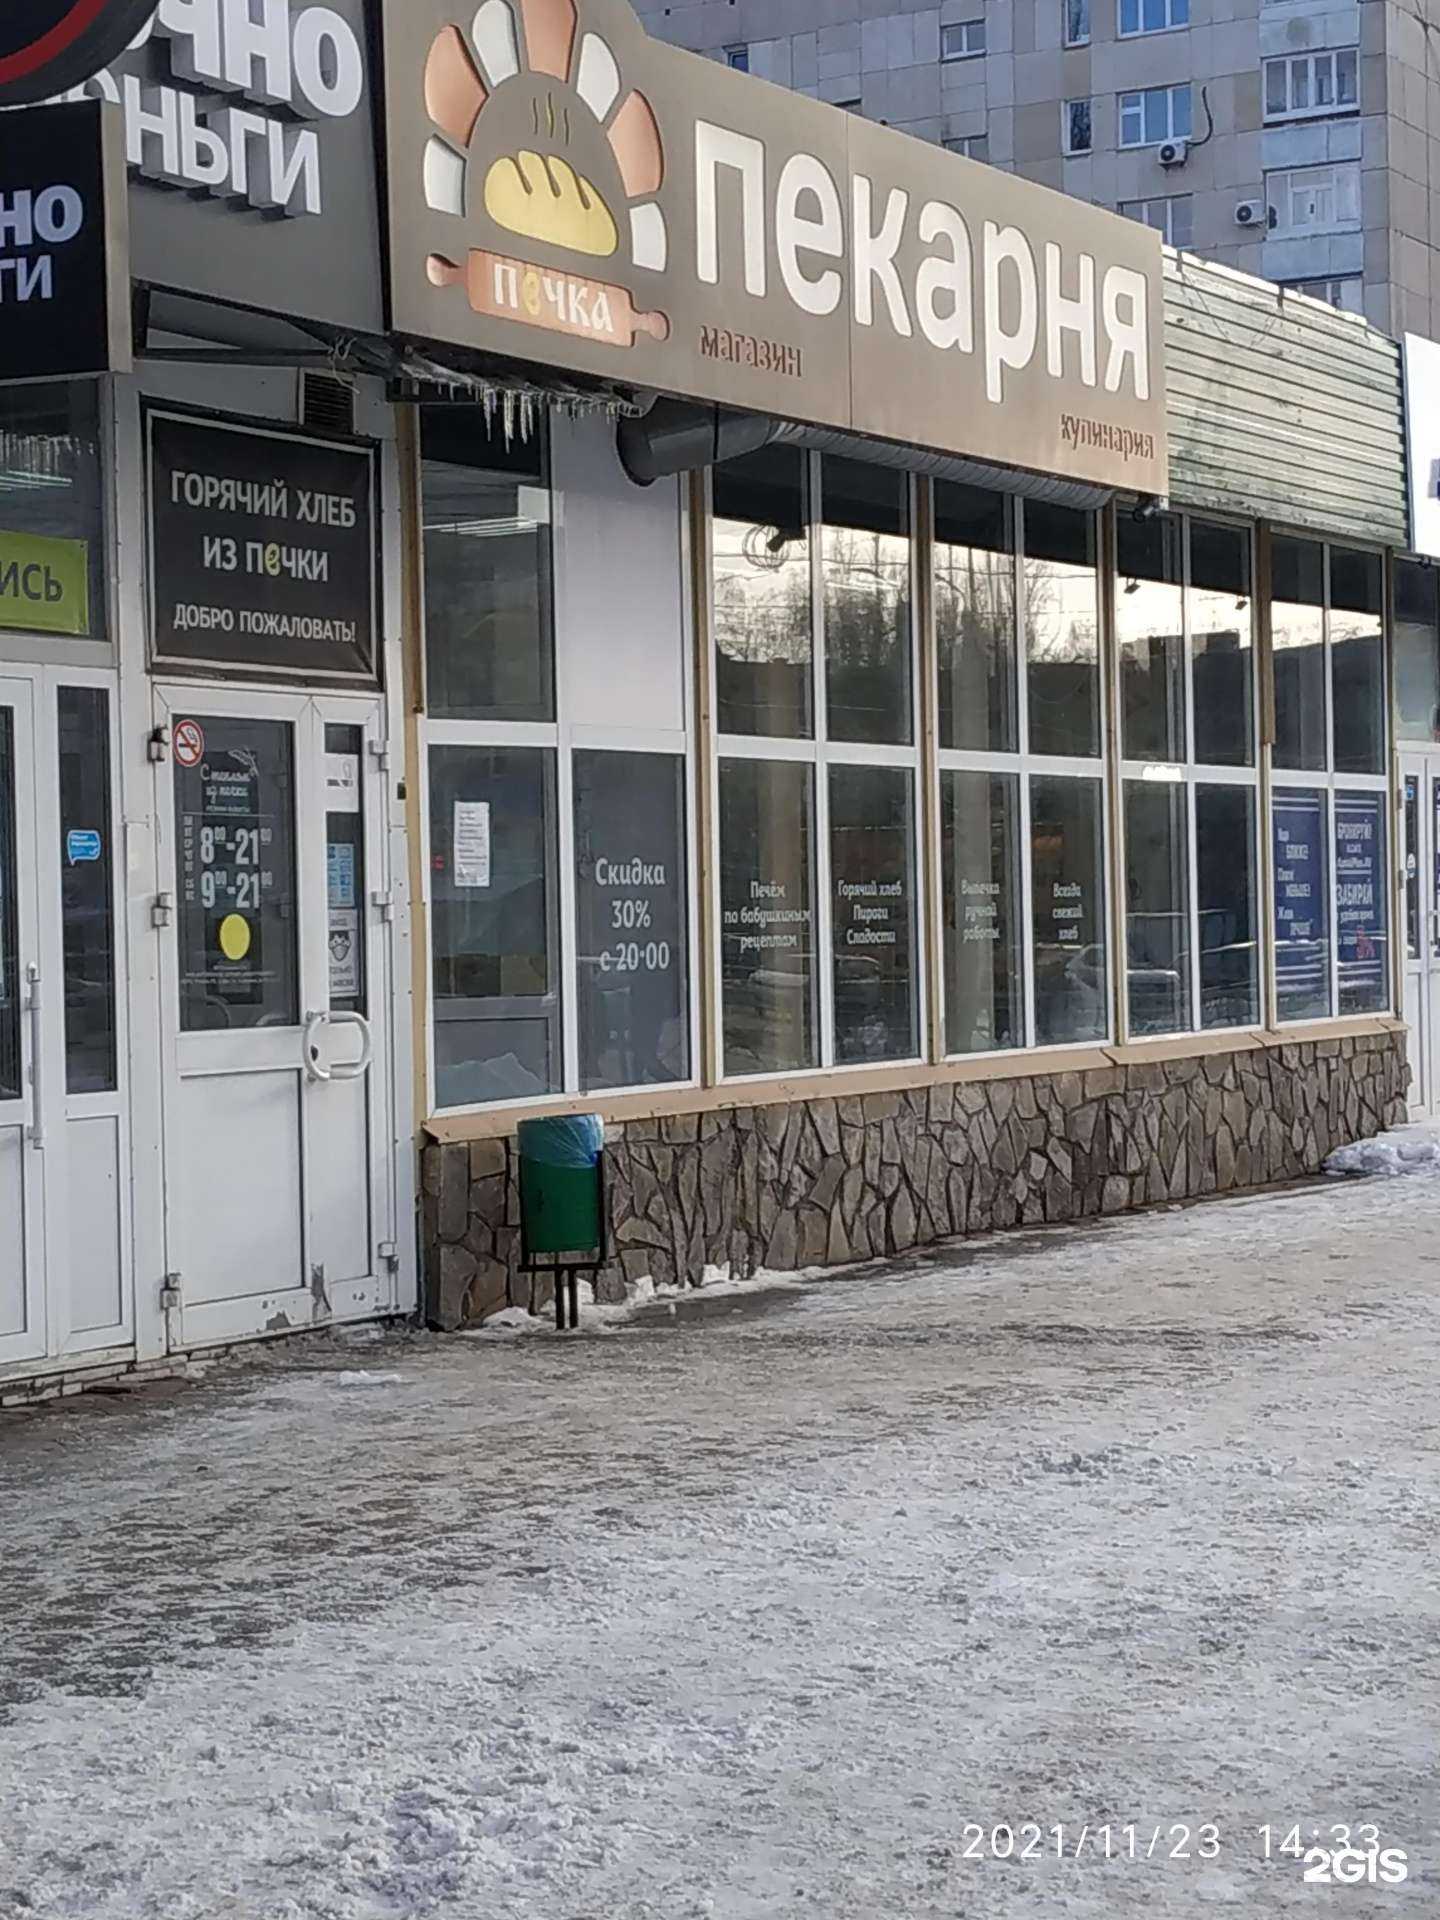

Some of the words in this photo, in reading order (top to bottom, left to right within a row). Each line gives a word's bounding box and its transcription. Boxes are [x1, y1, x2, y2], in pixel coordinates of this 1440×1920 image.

[700, 325, 801, 377] магазин
[1061, 414, 1154, 462] кулинария
[171, 469, 288, 518] ГОРЯЧИЙ
[296, 490, 356, 528] ХЛЕБ
[203, 536, 236, 571] ИЗ
[173, 603, 234, 631] ДОБРО
[239, 610, 356, 643] ПОЖАЛОВАТЬ!
[595, 857, 666, 886] Скидка
[611, 900, 651, 928] 30%
